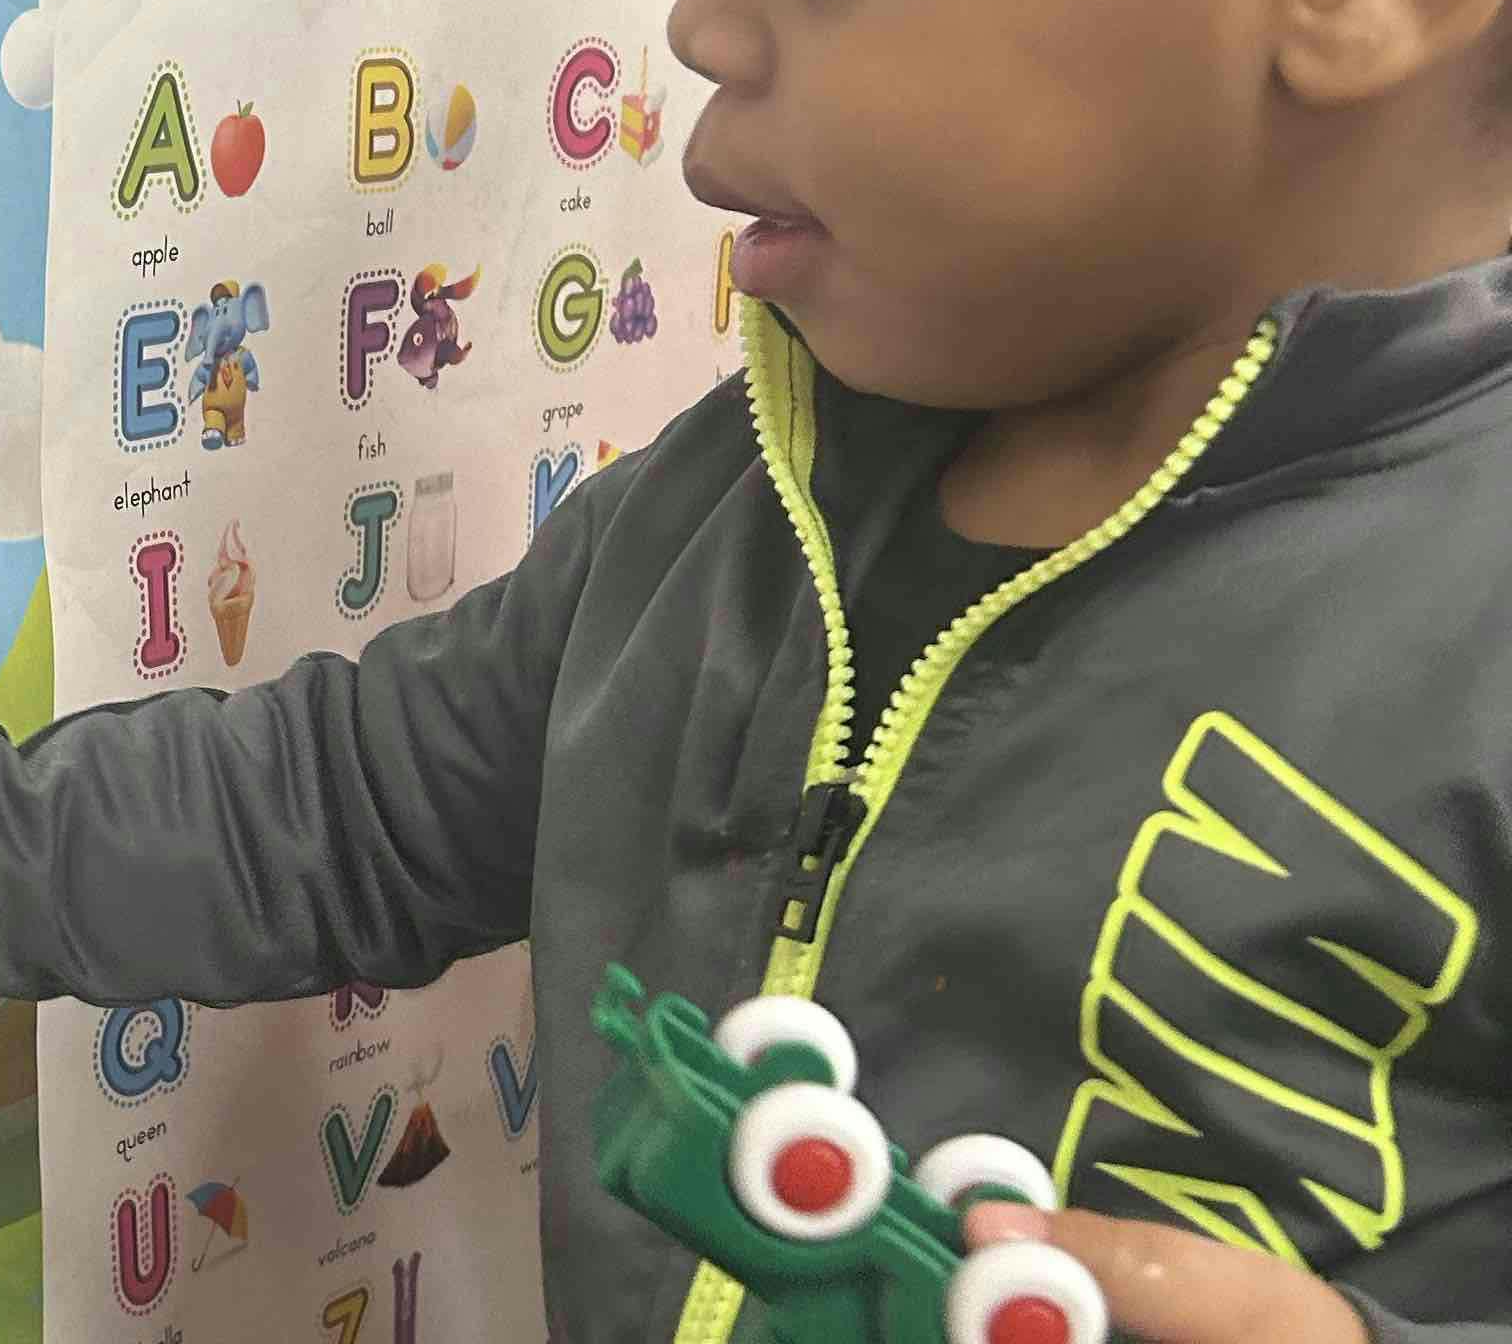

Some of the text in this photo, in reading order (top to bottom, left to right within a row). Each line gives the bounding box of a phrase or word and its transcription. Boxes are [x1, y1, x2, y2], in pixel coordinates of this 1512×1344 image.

[117, 72, 200, 210] A
[352, 57, 415, 185] B
[550, 46, 617, 161] C
[130, 235, 181, 279] apple
[364, 209, 395, 239] ball
[558, 189, 593, 213] cake
[345, 278, 400, 402] F
[536, 252, 605, 364] G
[119, 308, 182, 442] E
[540, 400, 585, 434] grape
[113, 470, 192, 519] elephant
[356, 433, 387, 461] fish
[136, 541, 181, 670] I
[341, 490, 400, 611] J
[99, 996, 185, 1098] Q
[328, 1039, 391, 1073] rainbow
[115, 1119, 169, 1163] queen
[322, 1091, 395, 1208] V
[116, 1181, 172, 1308] U
